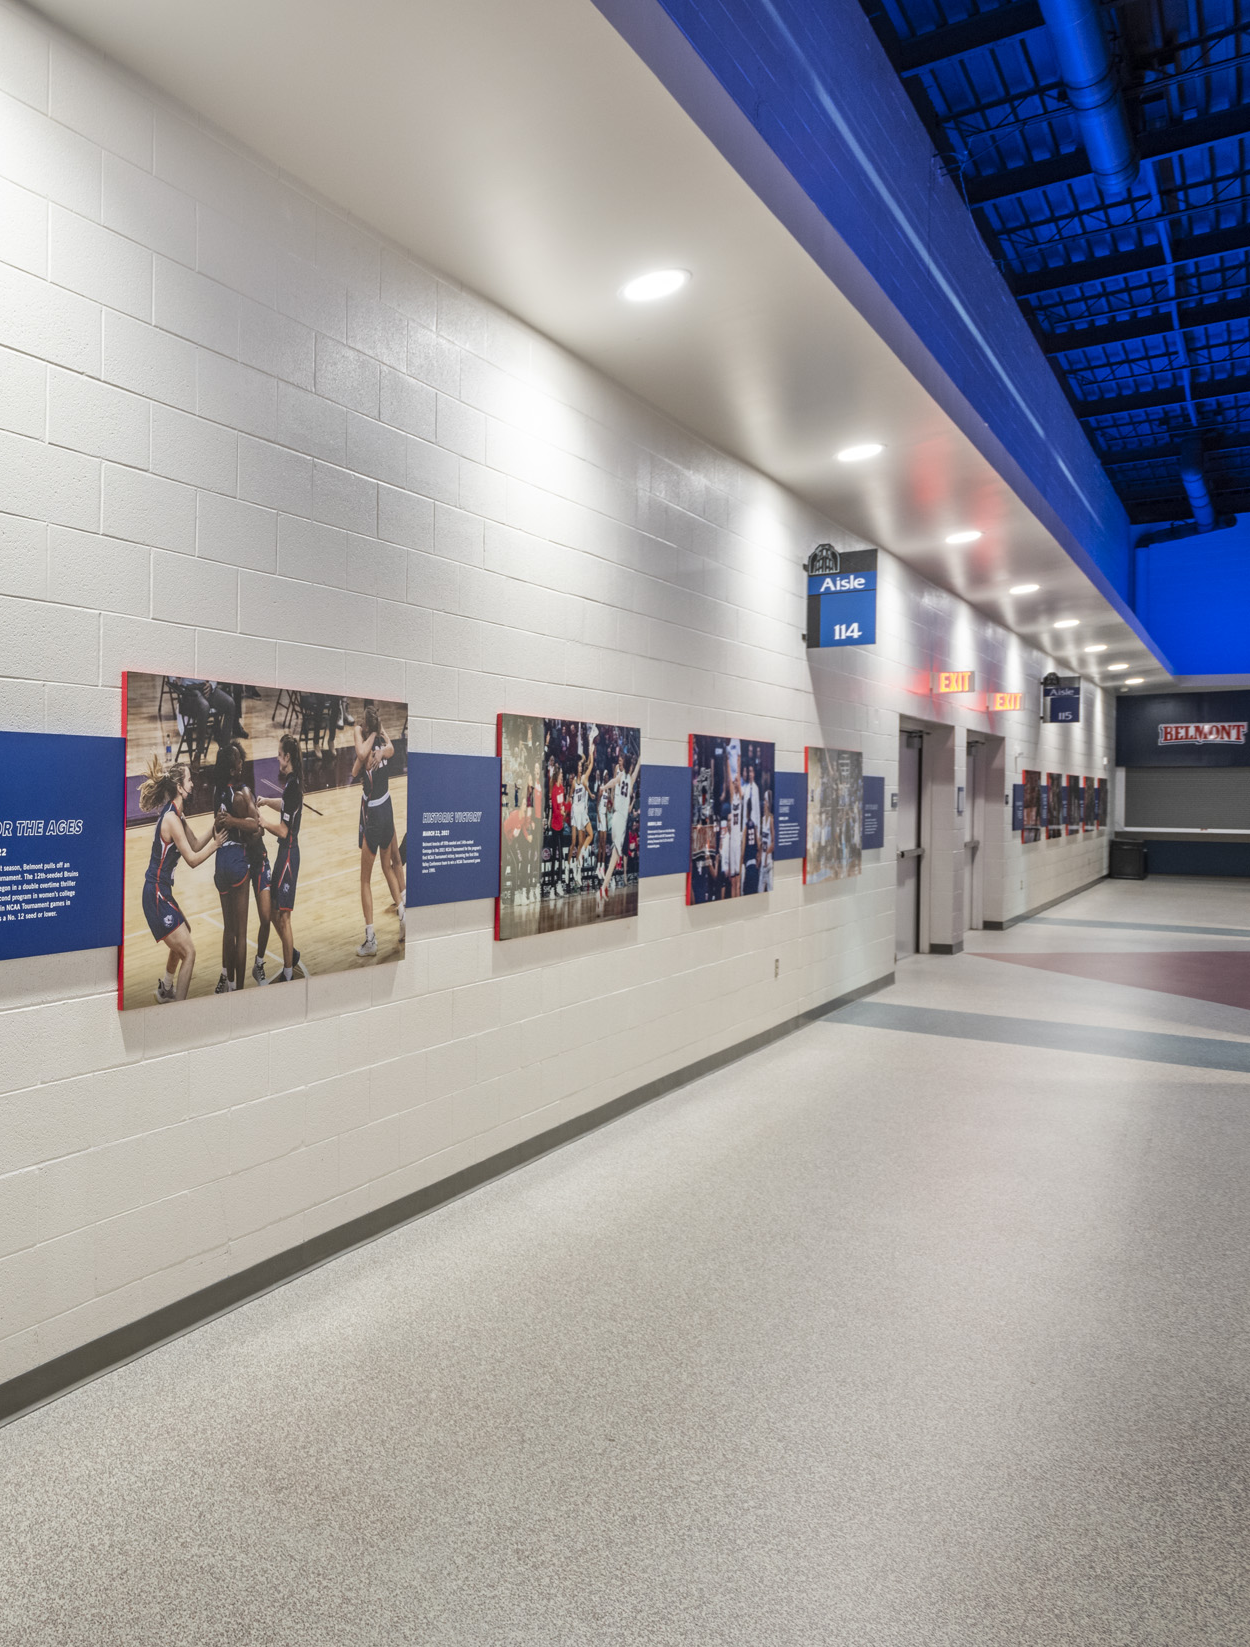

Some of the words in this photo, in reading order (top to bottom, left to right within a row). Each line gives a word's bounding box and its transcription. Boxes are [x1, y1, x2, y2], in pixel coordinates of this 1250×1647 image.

[820, 575, 866, 592] Aisle
[833, 622, 863, 640] 114
[939, 672, 971, 692] EXIT
[1050, 688, 1075, 696] Aisle
[994, 692, 1023, 710] EXIT
[1058, 711, 1073, 720] 115
[1161, 723, 1246, 742] BELMONT
[16, 821, 44, 836] THE
[46, 820, 83, 835] AGES
[44, 862, 55, 870] pulls
